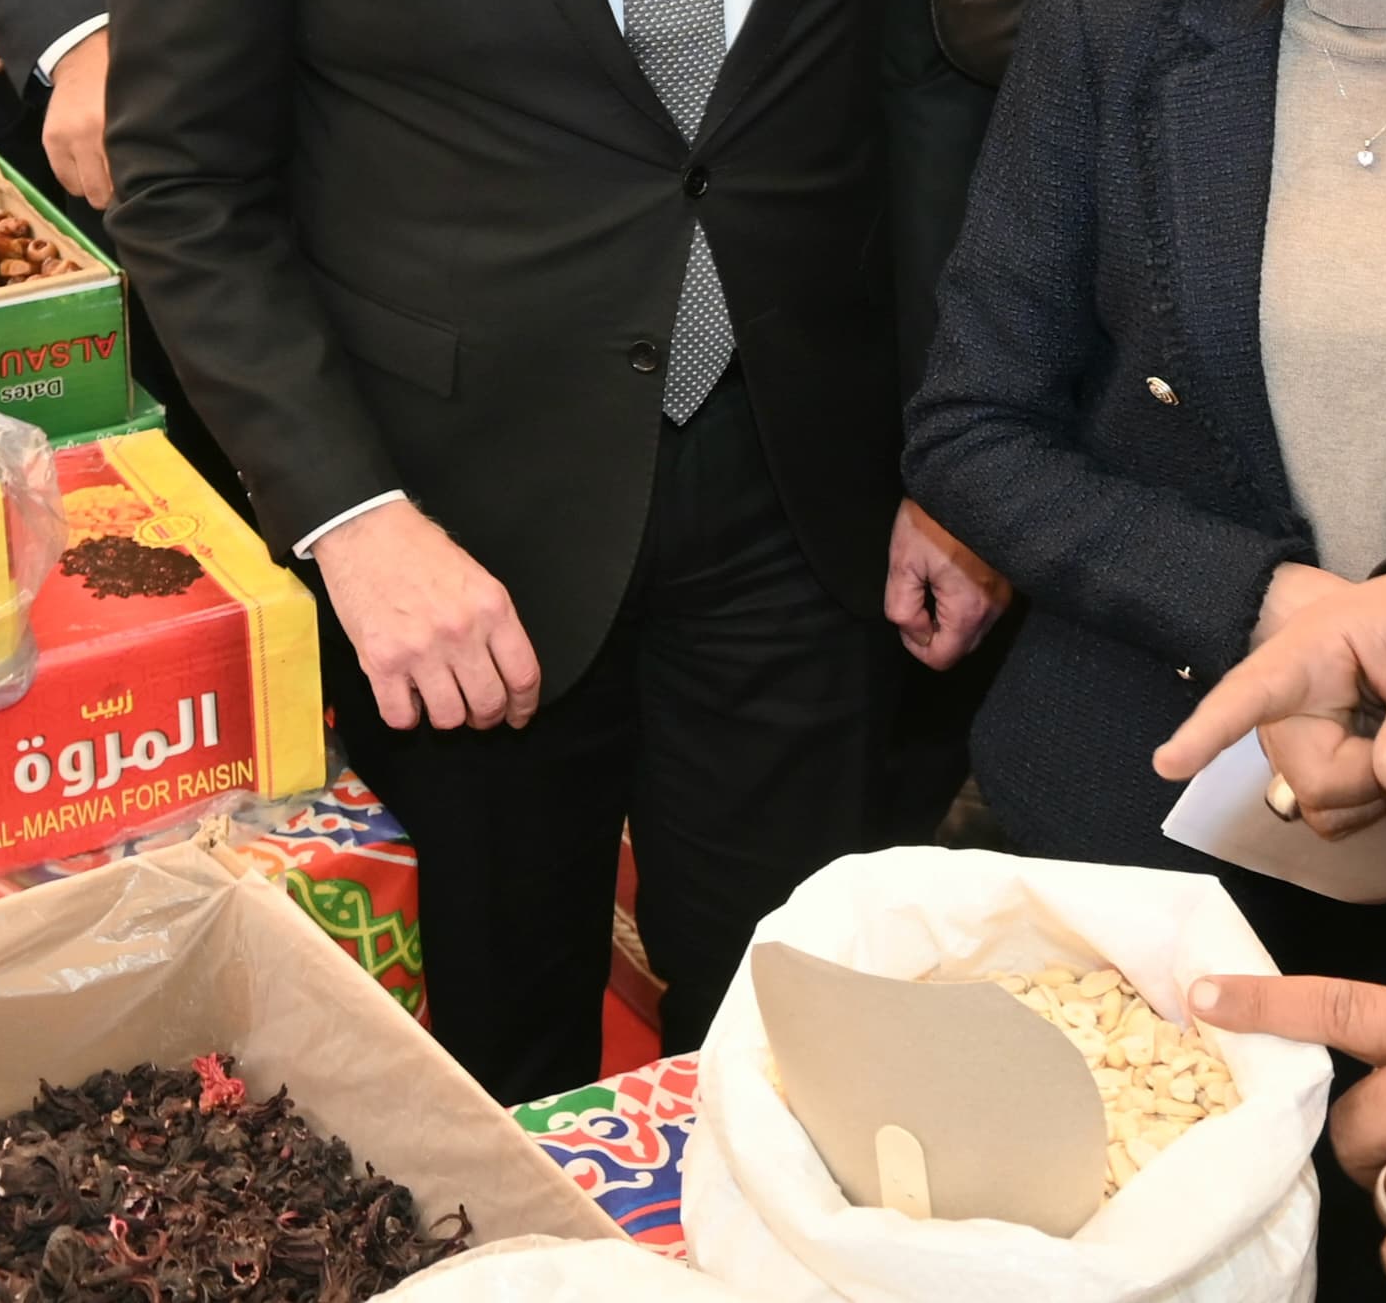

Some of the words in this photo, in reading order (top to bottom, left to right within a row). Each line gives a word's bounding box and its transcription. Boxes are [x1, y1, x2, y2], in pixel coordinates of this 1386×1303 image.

[0, 376, 63, 403] Dates
[81, 689, 134, 722] زبيب
[13, 691, 219, 798] المروة
[121, 779, 171, 816] FOR
[176, 757, 255, 801] RAISIN
